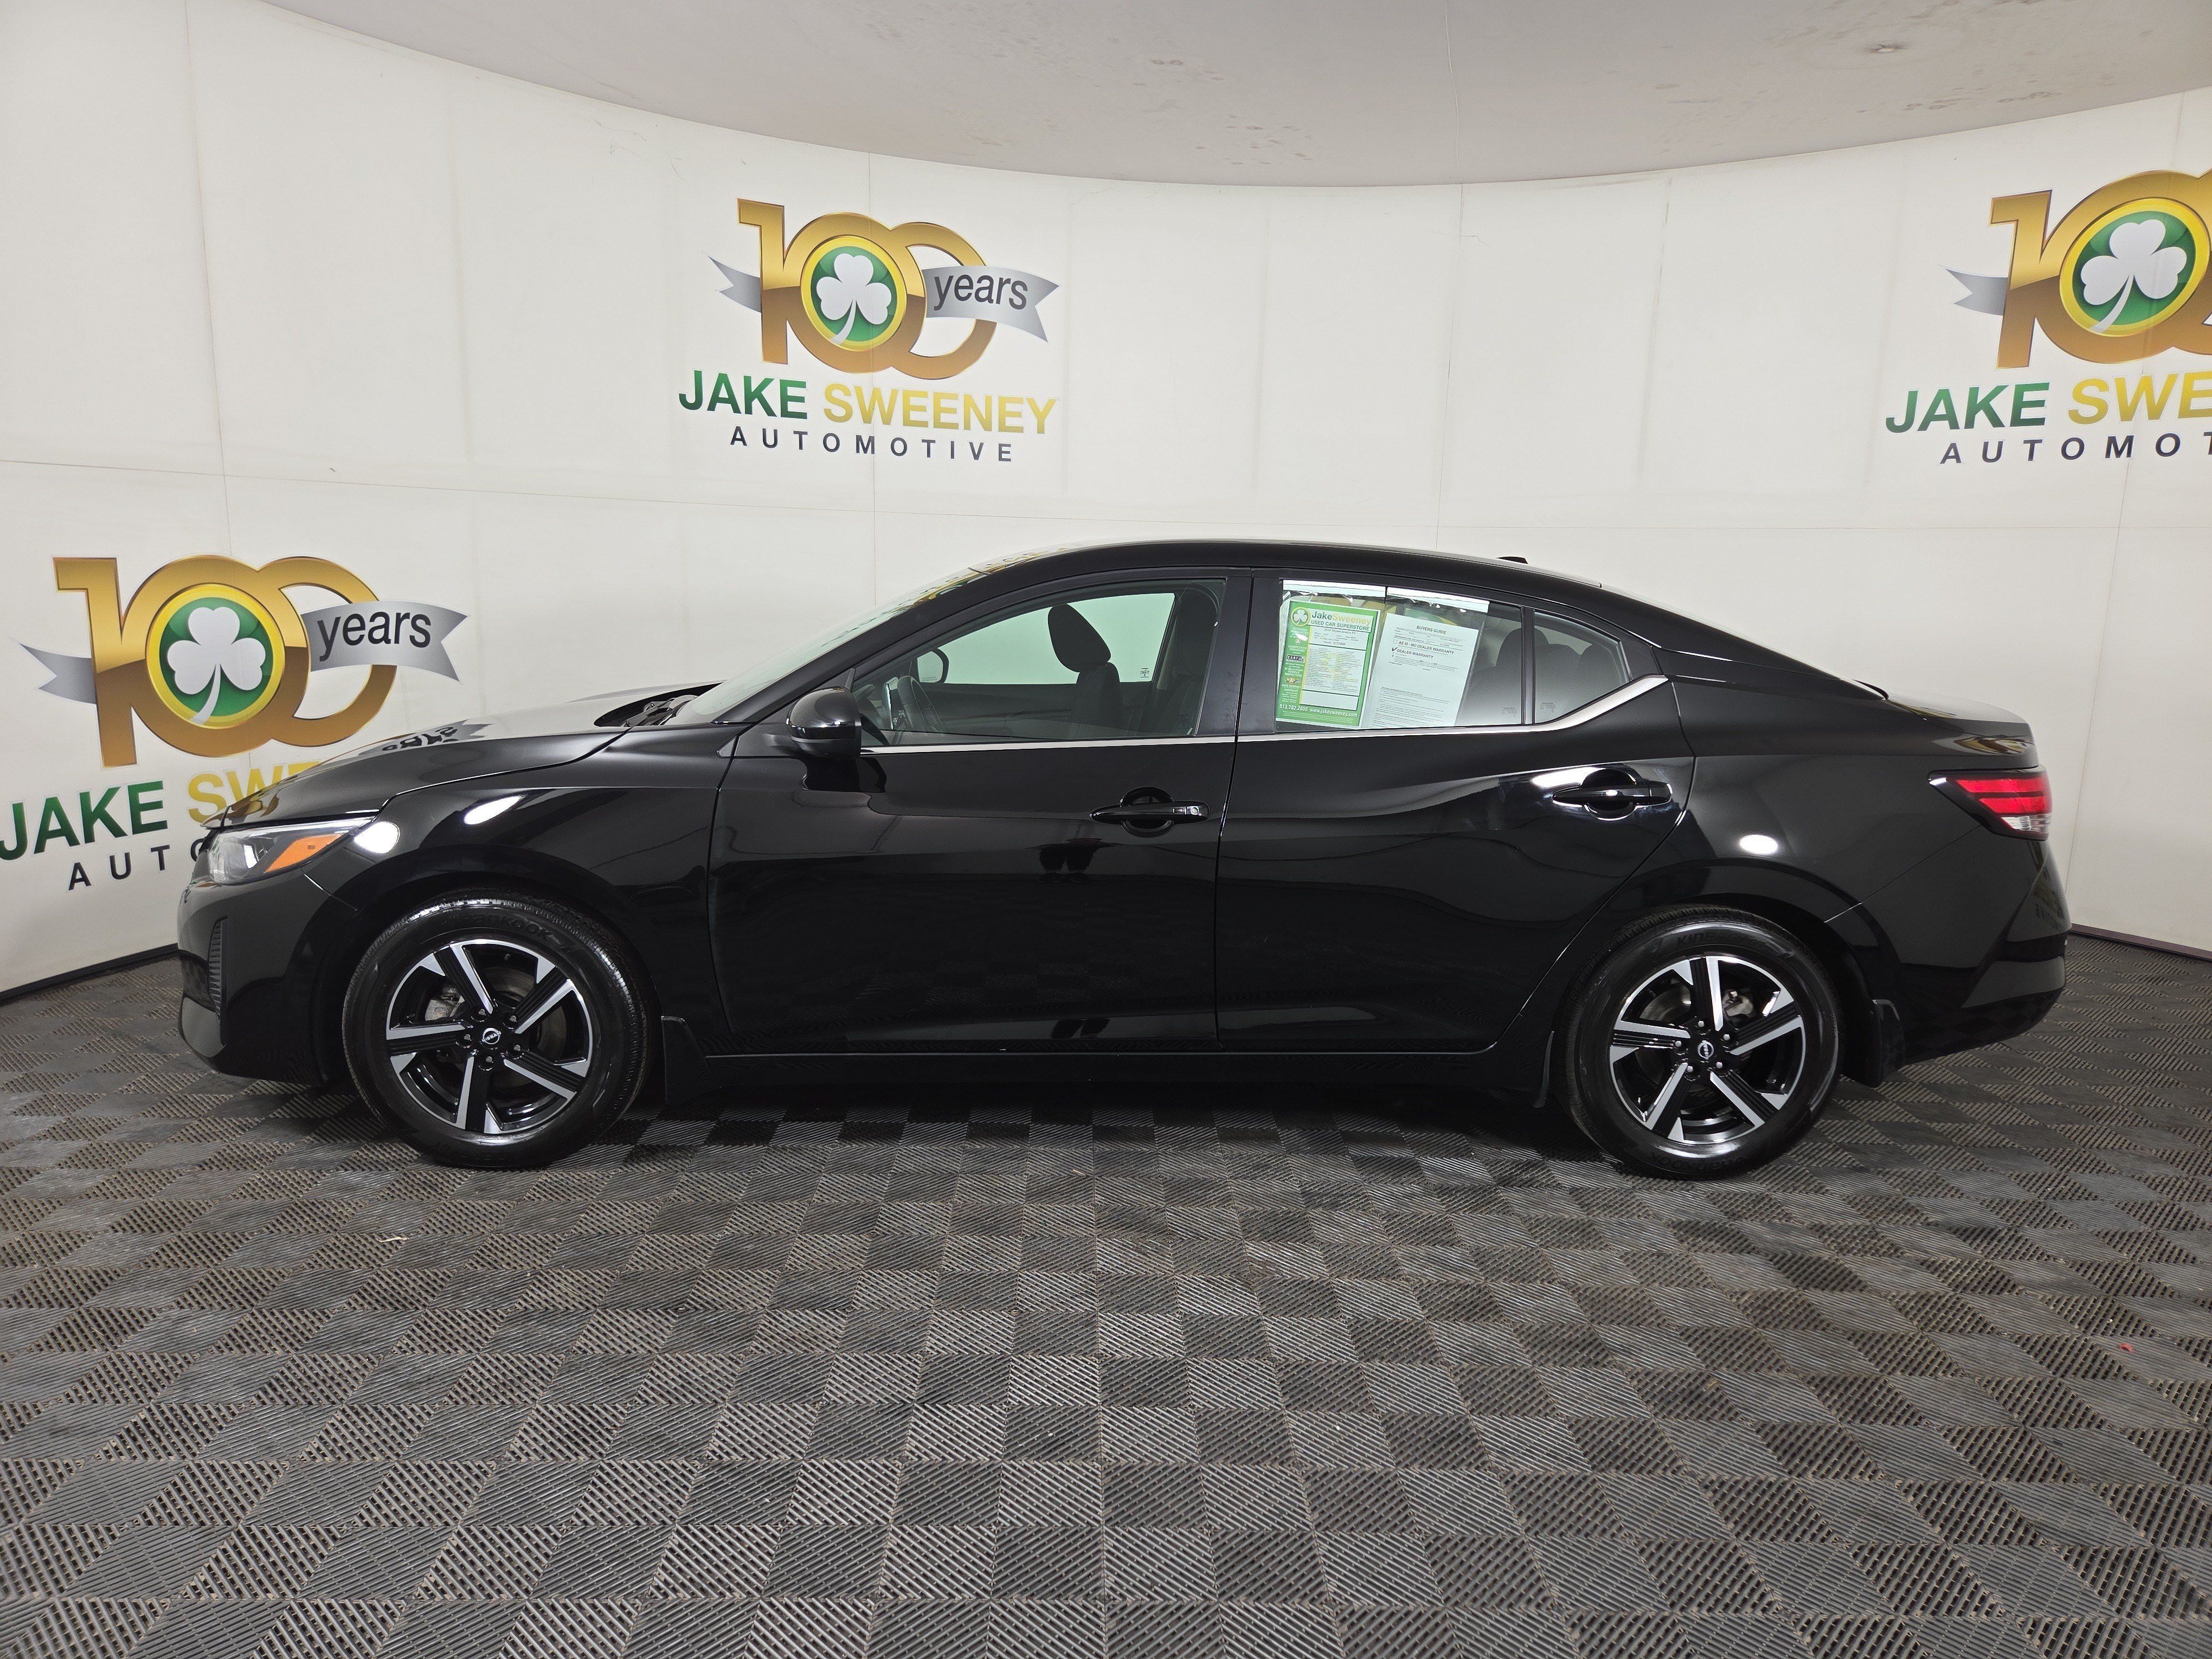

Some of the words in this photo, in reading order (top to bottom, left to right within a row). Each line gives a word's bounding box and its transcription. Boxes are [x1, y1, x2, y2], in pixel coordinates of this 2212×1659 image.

[737, 198, 997, 380] 100
[934, 274, 1028, 311] years
[1989, 168, 2212, 370] 10
[678, 369, 808, 420] JAKE
[824, 382, 1057, 434] SWEENEY
[1886, 381, 2050, 433] JAKE
[2068, 371, 2212, 425] SWE
[730, 426, 1012, 462] AUTOMOTIVE
[53, 555, 397, 768] 100
[317, 611, 432, 662] years
[1336, 623, 1370, 631] SUPERSTORE
[0, 781, 168, 860] JAKE
[188, 761, 319, 825] SW
